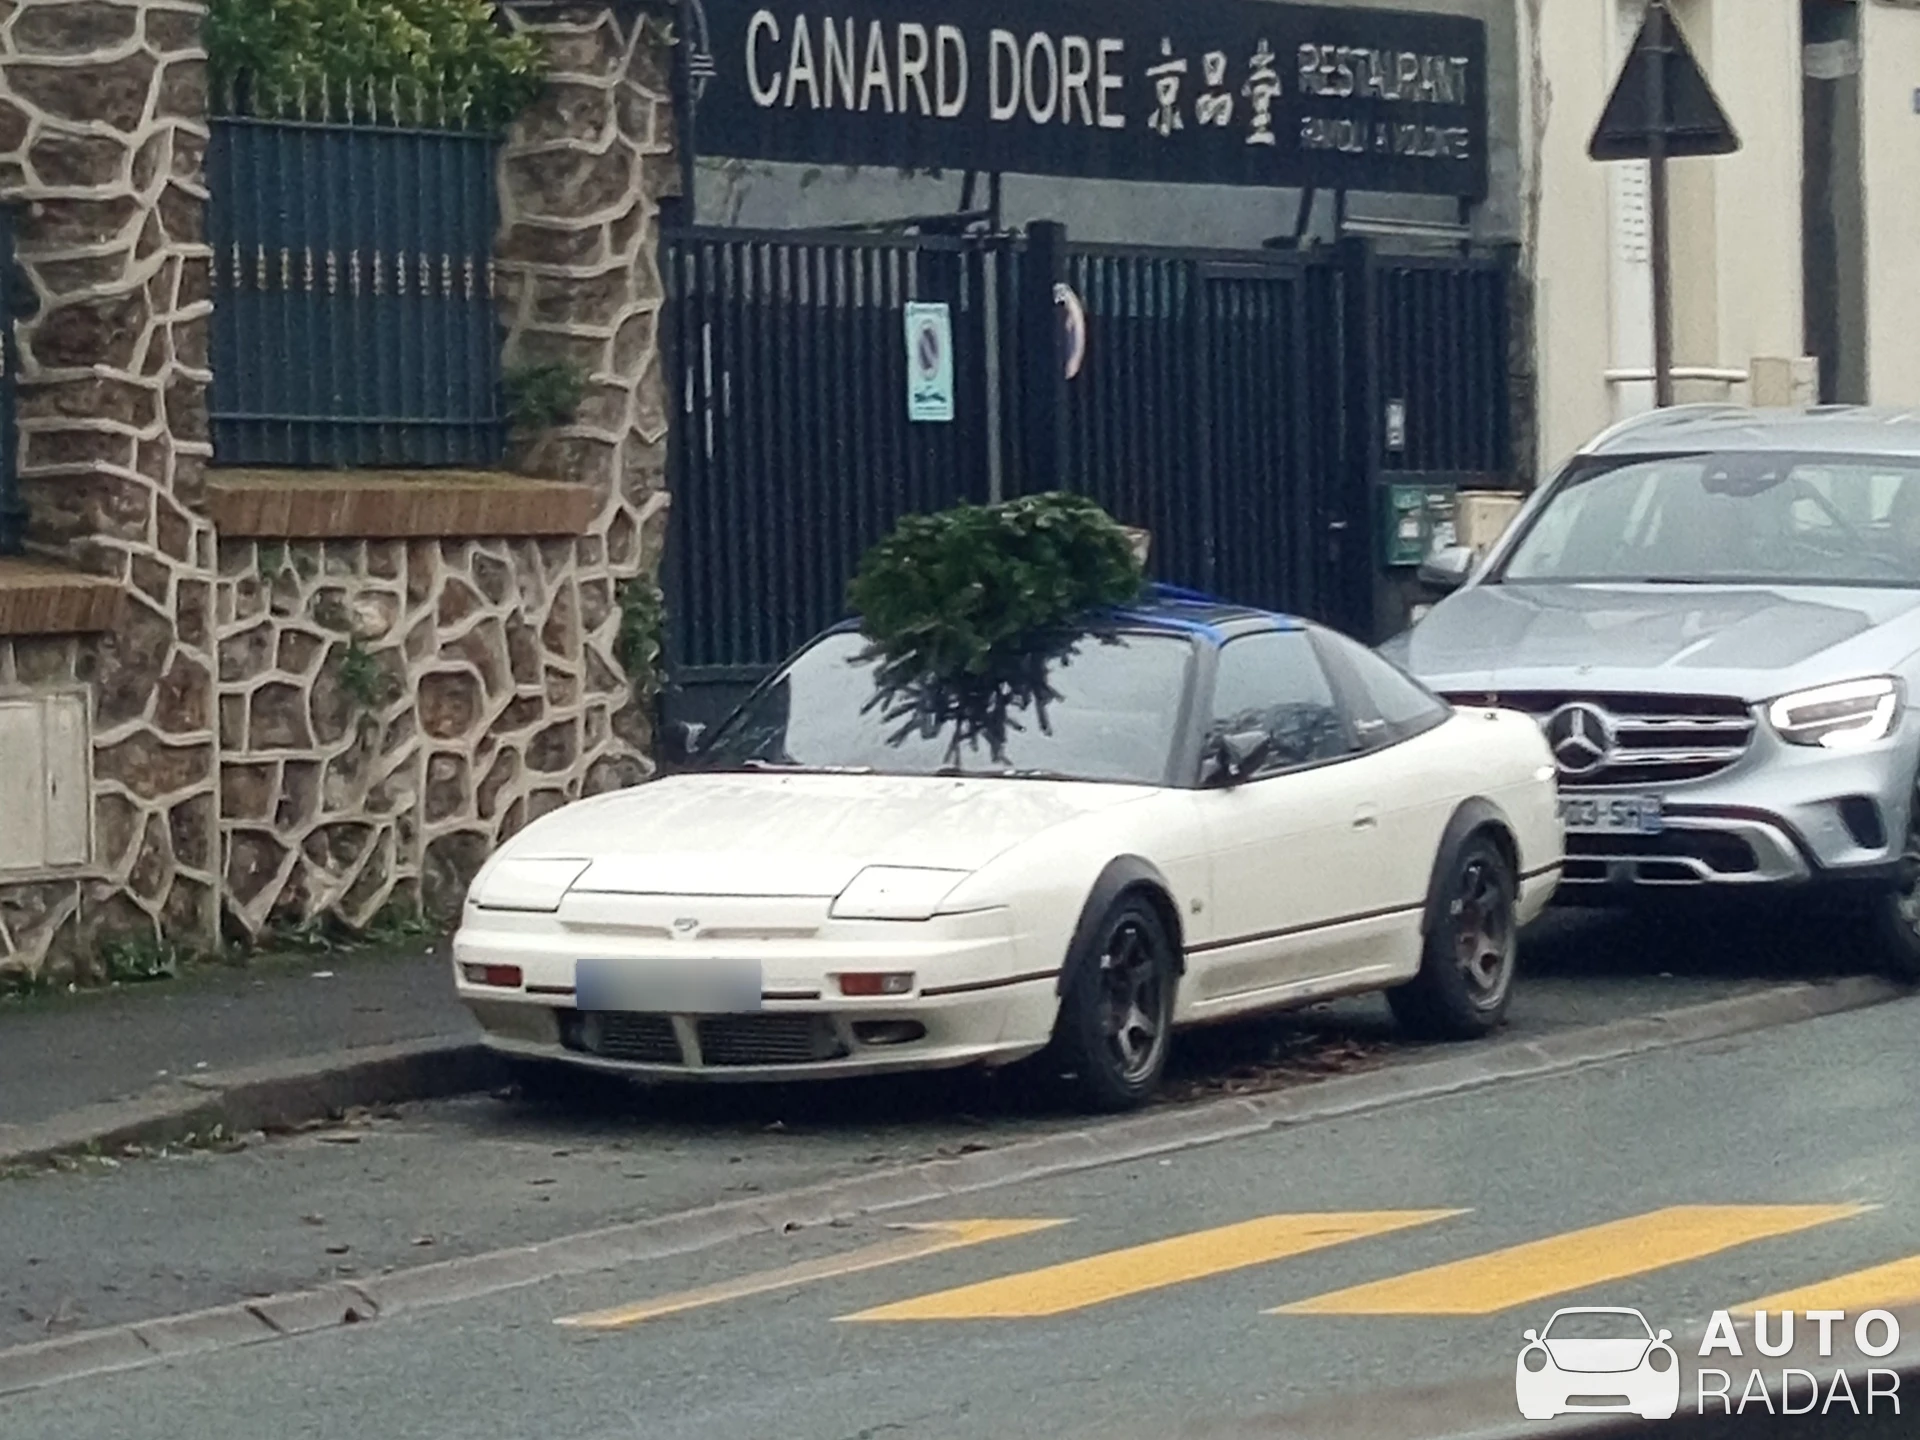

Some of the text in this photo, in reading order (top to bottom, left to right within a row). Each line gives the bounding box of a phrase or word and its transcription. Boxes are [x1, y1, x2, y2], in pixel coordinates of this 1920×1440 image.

[745, 9, 1126, 128] CANARD DORE
[1298, 43, 1469, 105] RESTAURANT
